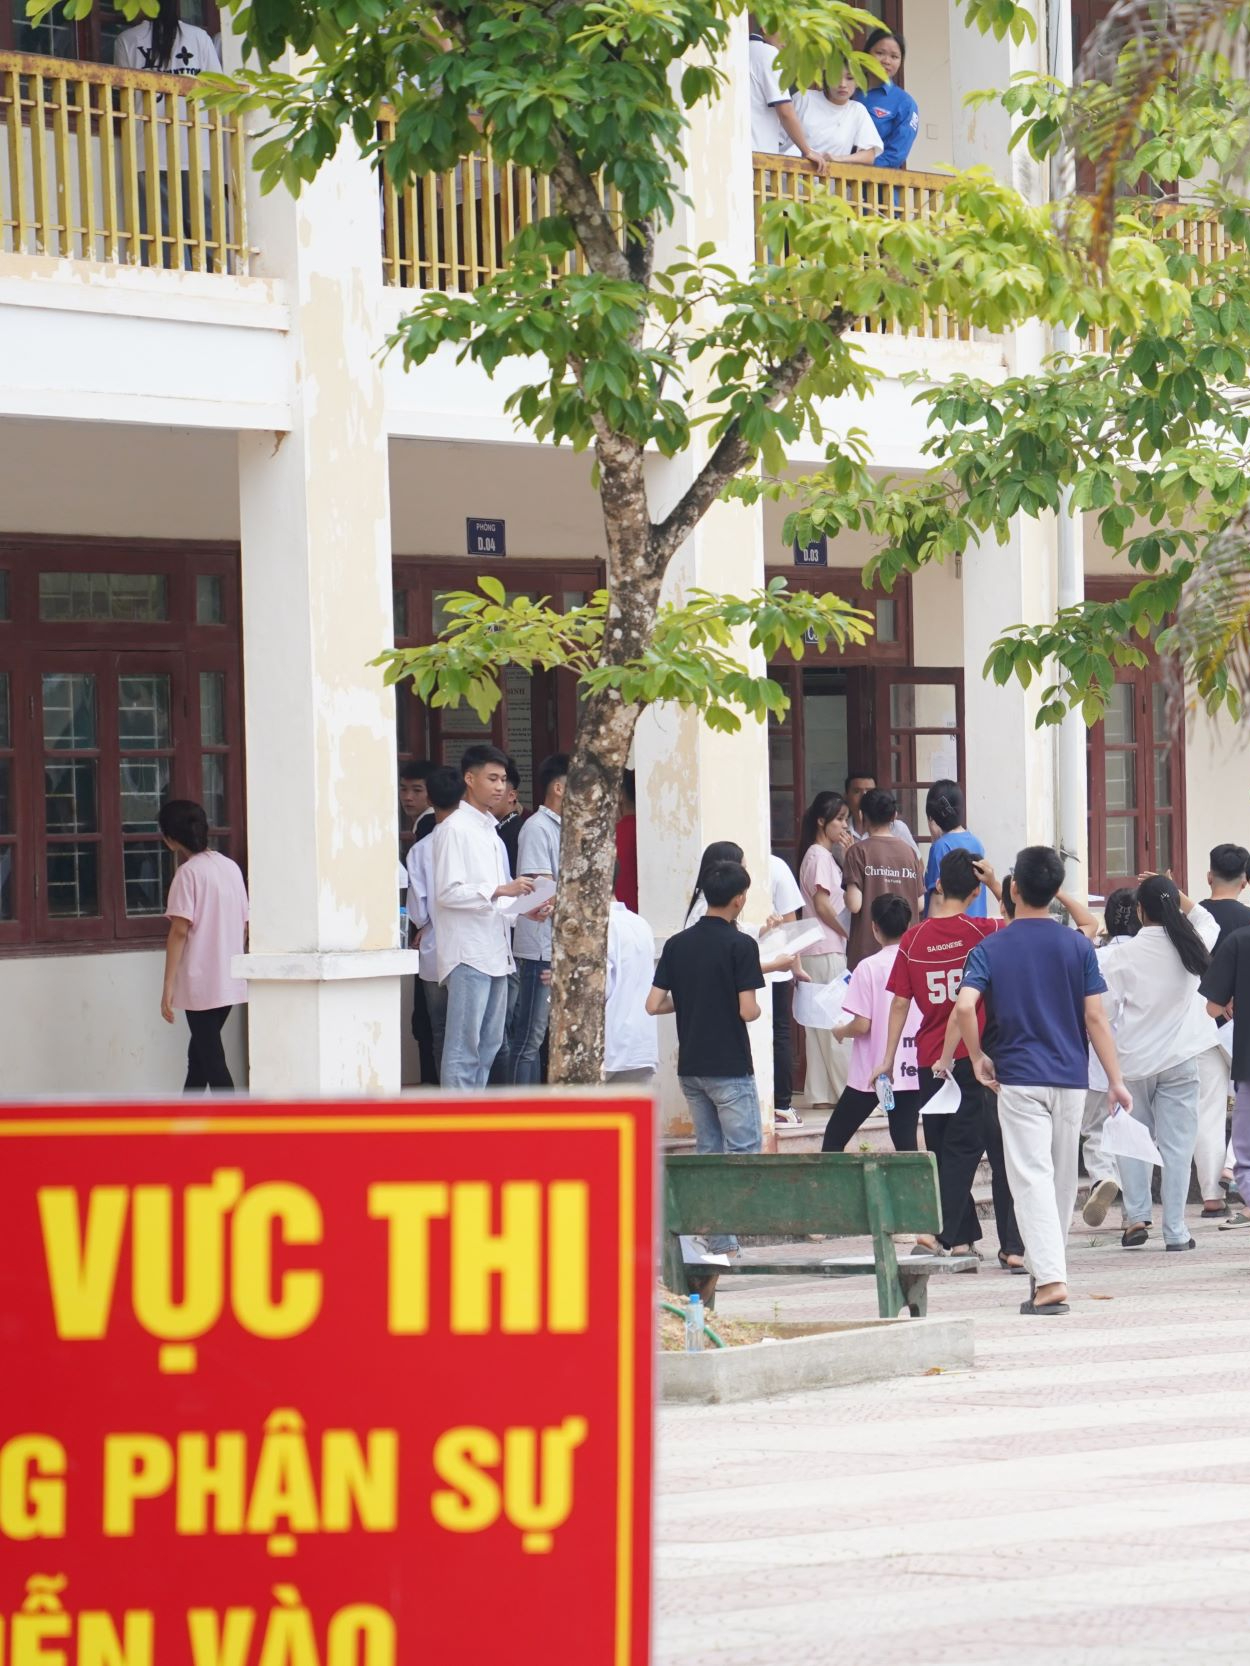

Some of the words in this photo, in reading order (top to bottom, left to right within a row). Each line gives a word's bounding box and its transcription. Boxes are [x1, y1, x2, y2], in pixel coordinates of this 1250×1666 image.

[477, 536, 496, 552] D.04
[803, 548, 819, 562] D.03
[864, 865, 900, 877] Christian
[926, 940, 963, 953] SAIGONESE
[900, 1061, 919, 1077] fe
[37, 1166, 324, 1375] VỰC
[367, 1179, 589, 1336] THI
[103, 1408, 398, 1557] PHẬN
[431, 1416, 588, 1554] SỰ
[0, 1572, 154, 1666] ỄN
